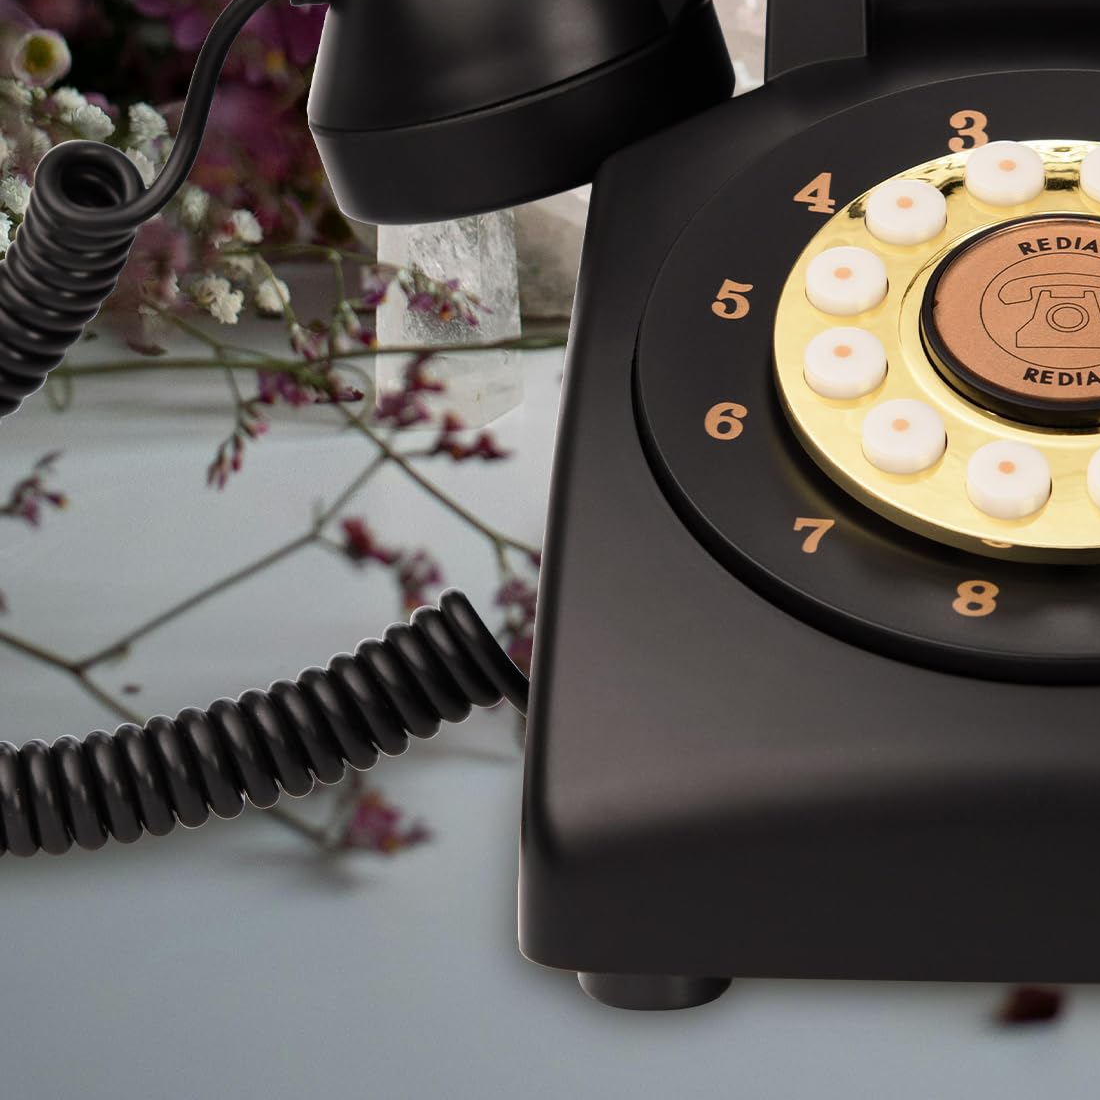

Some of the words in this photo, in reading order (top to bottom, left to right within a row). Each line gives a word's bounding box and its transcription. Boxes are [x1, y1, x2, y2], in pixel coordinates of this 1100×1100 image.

[948, 110, 988, 152] 3
[793, 172, 836, 214] 4
[711, 278, 753, 320] 5
[704, 401, 748, 441] 6
[794, 517, 836, 554] 7
[952, 580, 999, 617] 8
